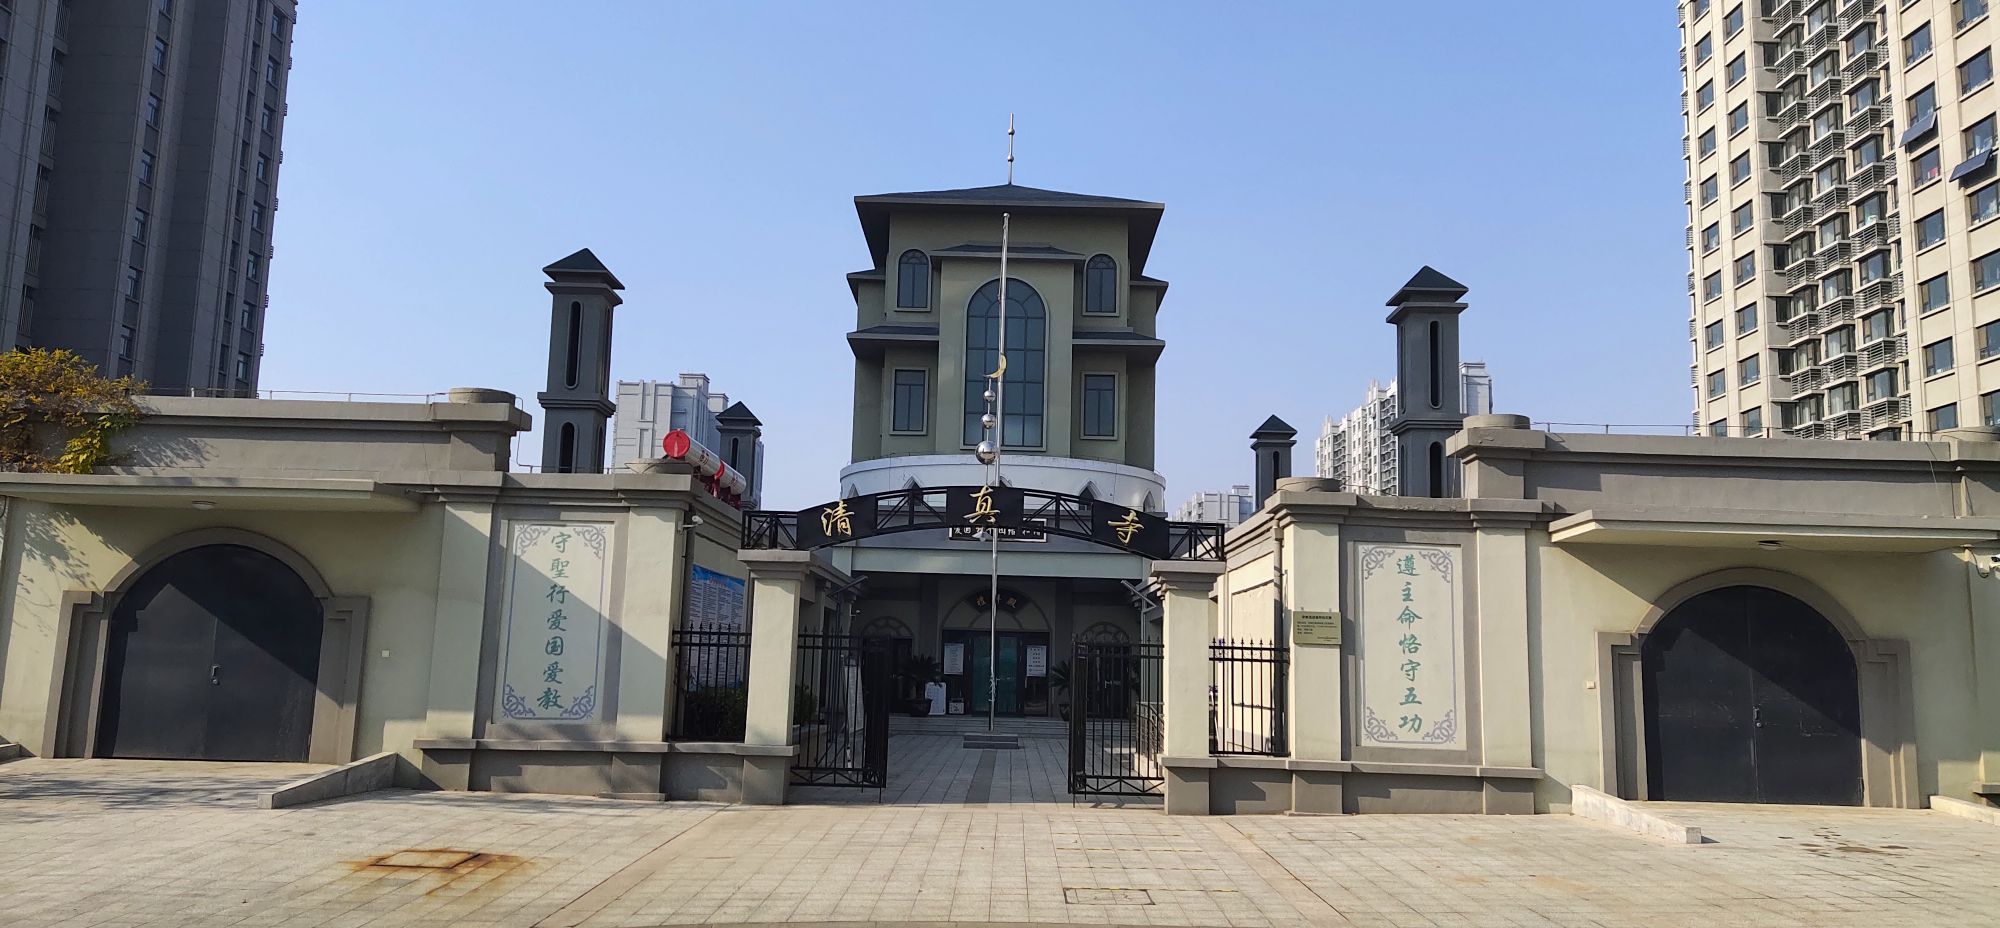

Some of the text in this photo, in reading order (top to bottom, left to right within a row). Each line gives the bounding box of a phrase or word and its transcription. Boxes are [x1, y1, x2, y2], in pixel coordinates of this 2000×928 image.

[821, 485, 1144, 545] 清真寺
[1396, 553, 1423, 734] 遵主命恪守五功
